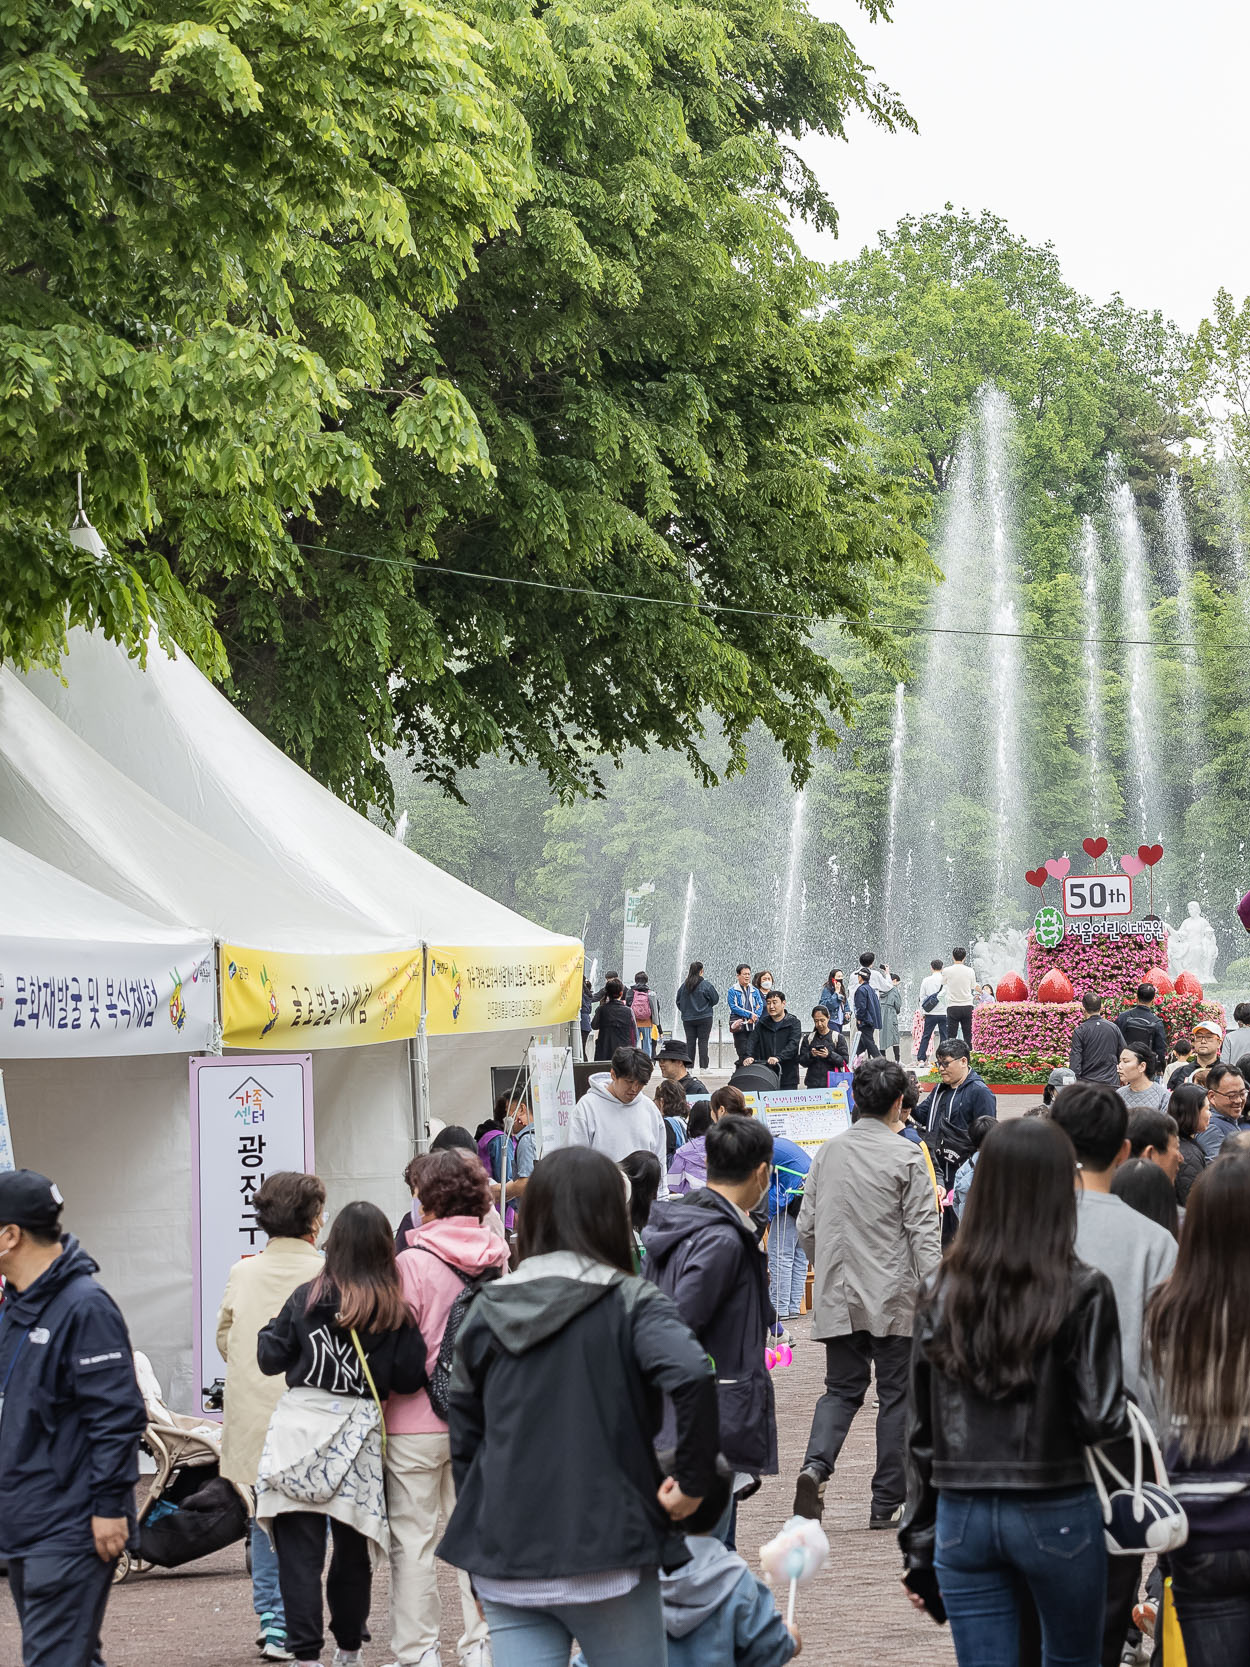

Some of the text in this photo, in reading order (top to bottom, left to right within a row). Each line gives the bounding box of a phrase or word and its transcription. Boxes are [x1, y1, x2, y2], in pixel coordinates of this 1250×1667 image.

[1069, 882, 1126, 909] 50th
[1067, 921, 1164, 945] 서울어린이대공원
[13, 975, 83, 1030] 문화재발굴
[87, 976, 101, 1030] 및
[105, 976, 158, 1030] 복식체험
[235, 1089, 265, 1111] 가족
[234, 1106, 265, 1125] 센터
